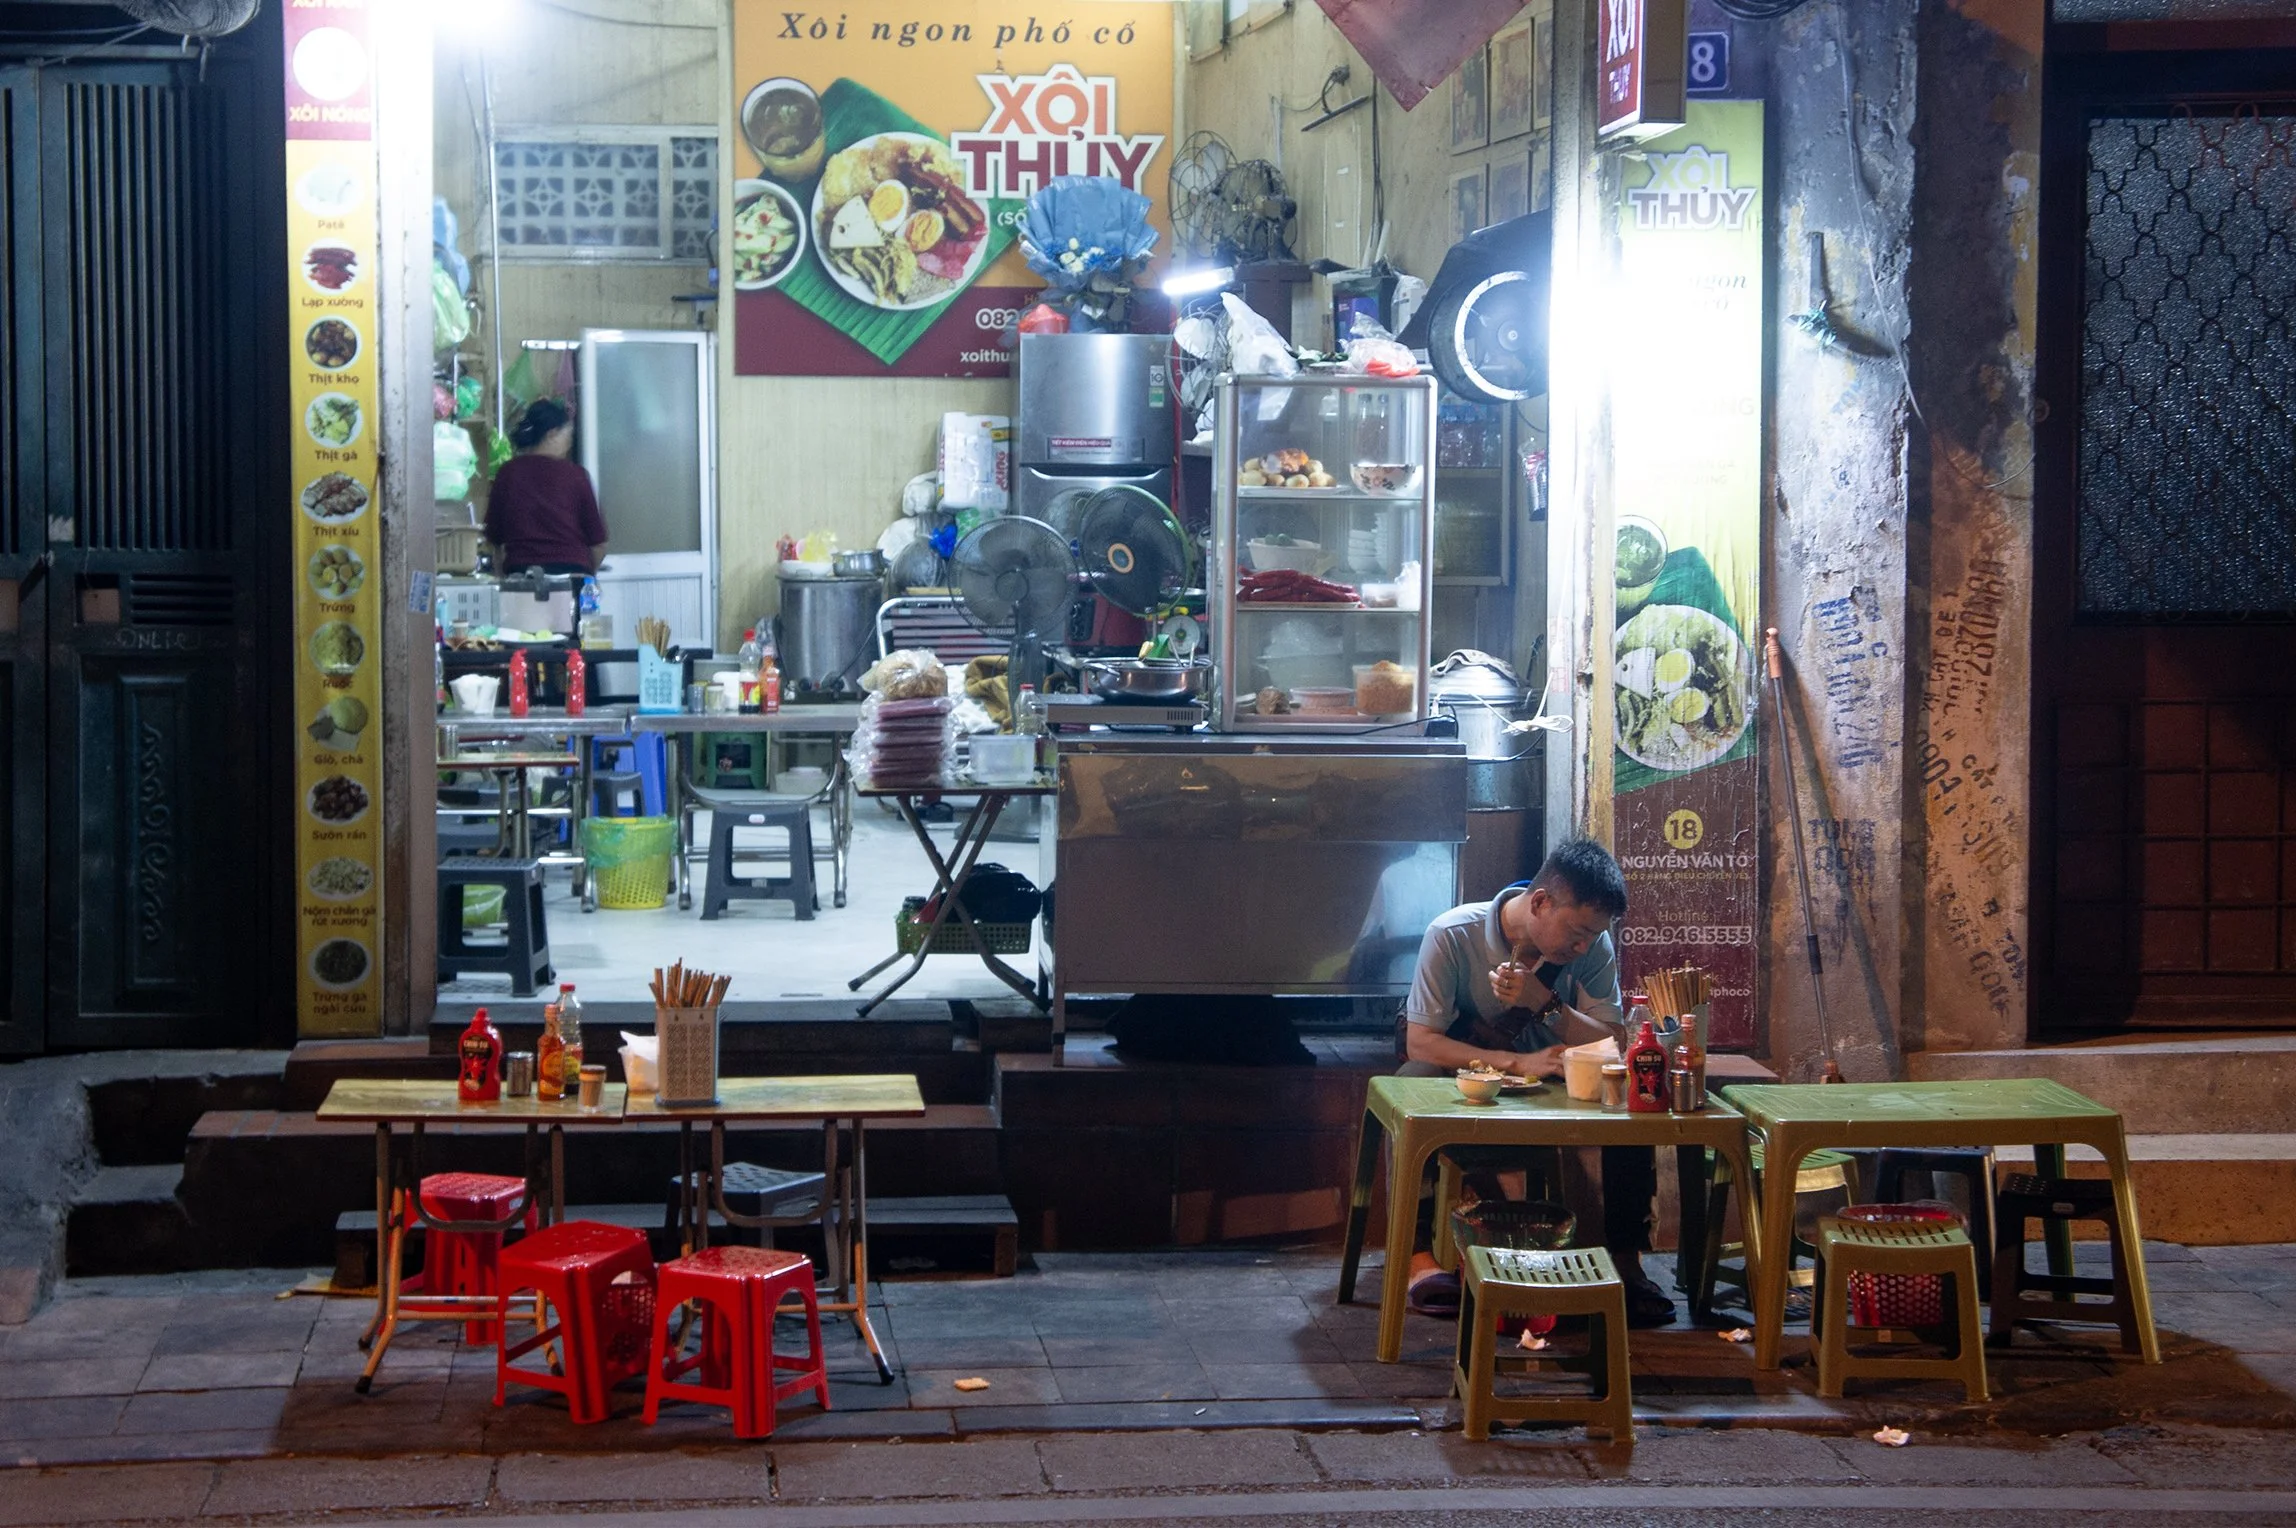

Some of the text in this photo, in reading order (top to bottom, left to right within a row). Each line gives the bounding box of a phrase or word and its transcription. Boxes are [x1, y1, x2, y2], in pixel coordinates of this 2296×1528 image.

[777, 13, 848, 40] Xôi
[871, 19, 974, 47] ngon
[993, 16, 1073, 48] phố
[289, 102, 319, 121] XÔI
[989, 70, 1108, 136] XÔI
[958, 129, 1153, 198] THỦY
[1650, 149, 1724, 190] XÔI
[1631, 186, 1749, 226] THỦY
[309, 373, 333, 385] Thịt
[315, 450, 339, 462] Thịt
[313, 526, 337, 538] Thịt
[1669, 819, 1698, 841] 18
[1622, 849, 1688, 869] NGUYỄN
[1690, 852, 1723, 868] VĂN
